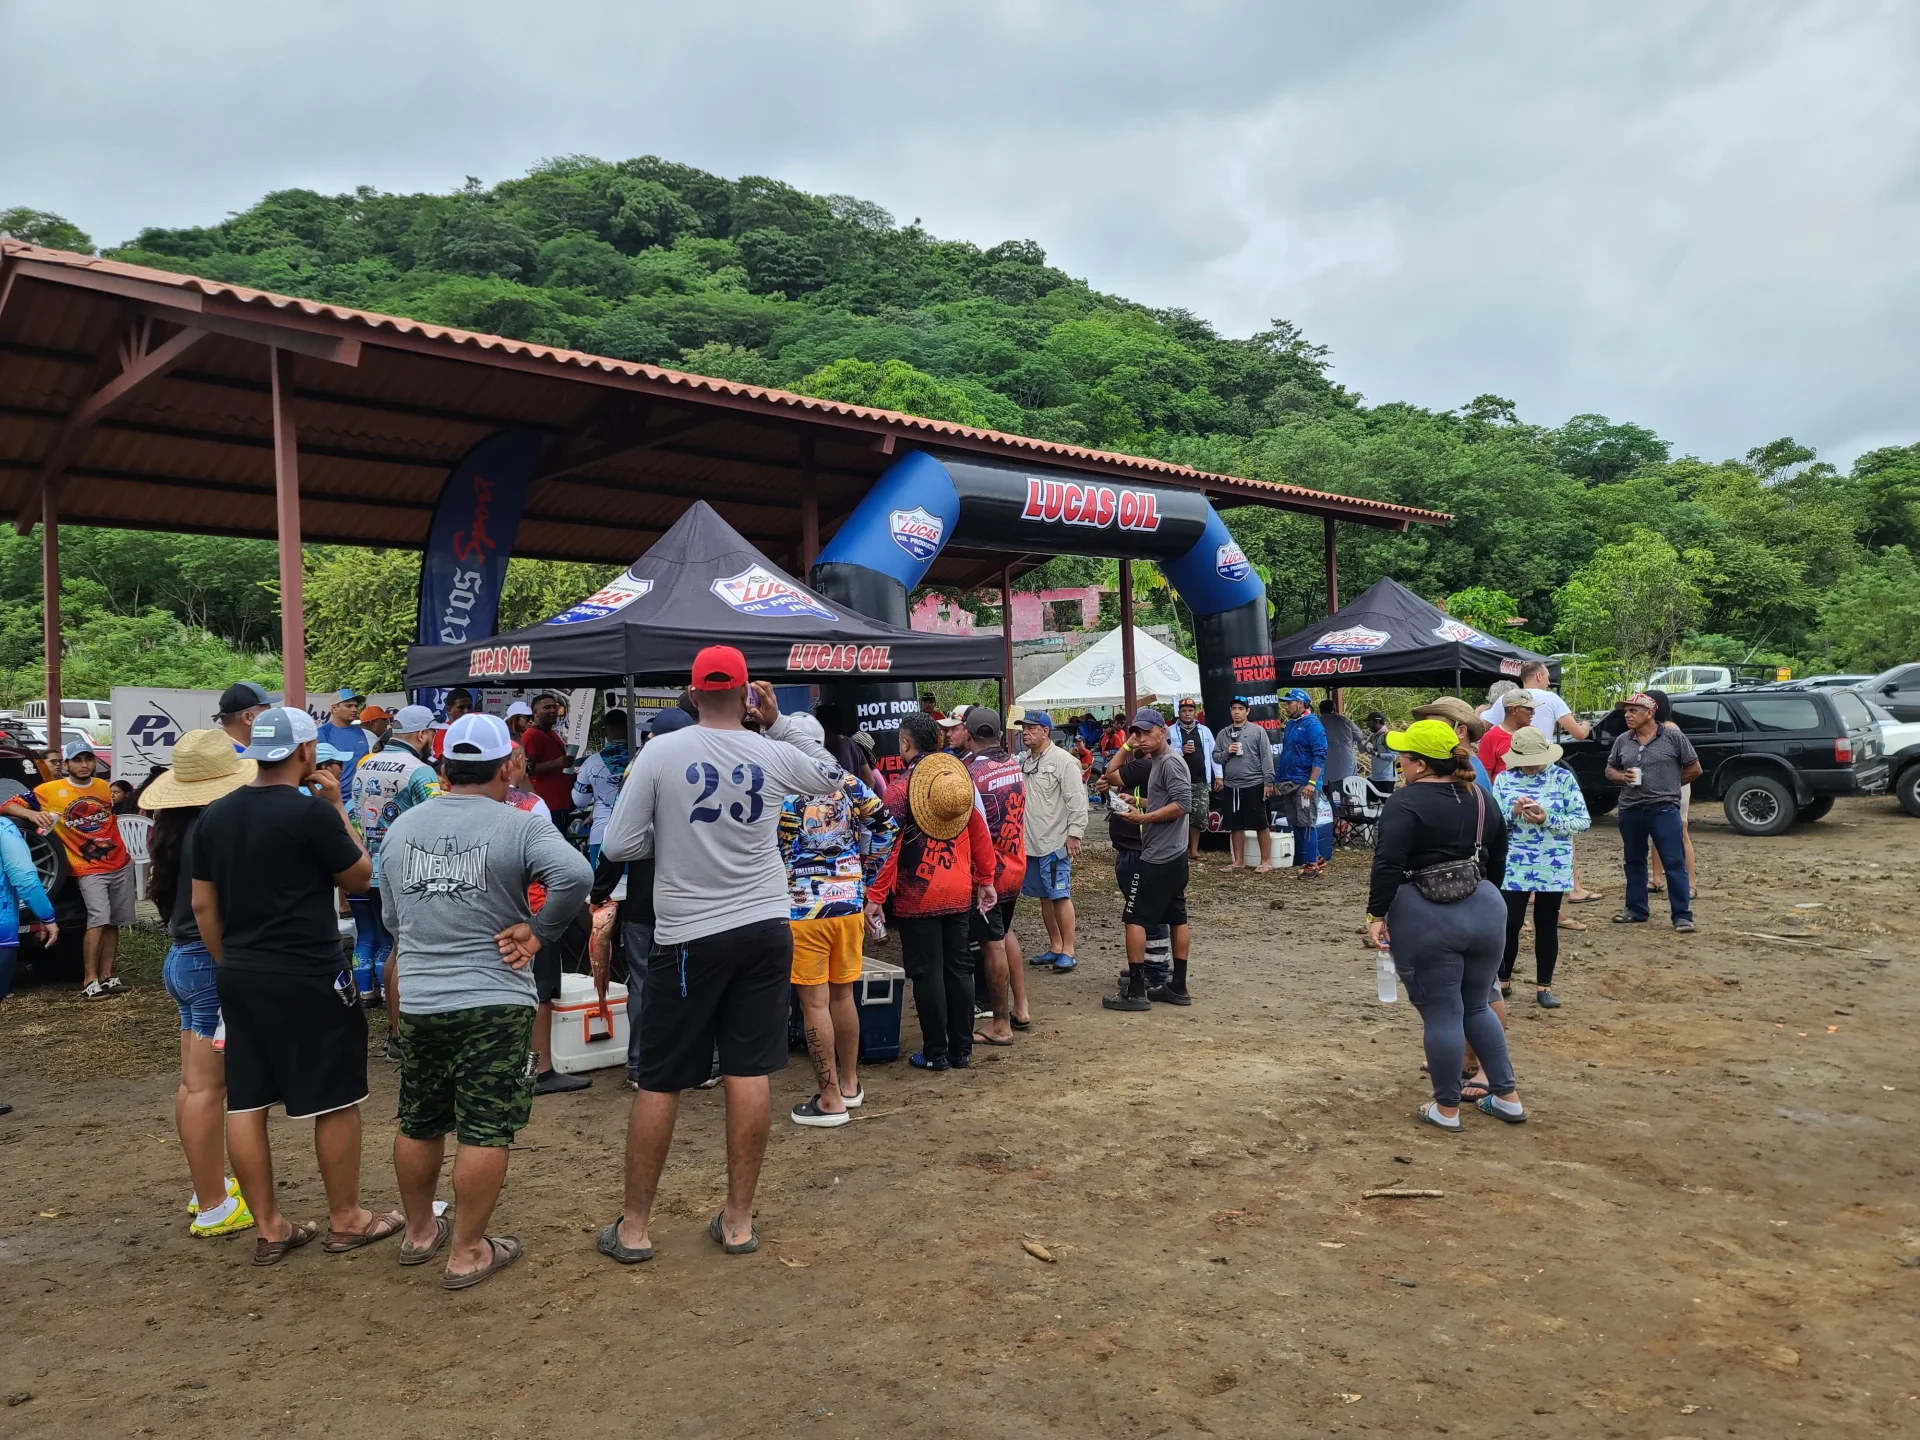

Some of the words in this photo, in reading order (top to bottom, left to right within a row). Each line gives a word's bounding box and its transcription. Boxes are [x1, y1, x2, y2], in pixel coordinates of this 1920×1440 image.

[1020, 478, 1116, 529] LUCAS
[1118, 489, 1162, 532] OIL
[900, 522, 939, 540] LUCAS
[743, 603, 769, 612] OIL
[469, 646, 508, 676] LUCAS
[509, 645, 532, 674] OIL
[786, 644, 858, 672] LUCAS
[858, 645, 893, 673] OIL
[1232, 656, 1269, 669] HEAVY
[1292, 658, 1337, 676] LUCAS
[1338, 656, 1362, 673] OIL
[639, 698, 660, 708] CHAME
[857, 701, 887, 717] HOT
[890, 700, 919, 714] RODS
[361, 759, 407, 773] MENDOZA
[685, 761, 765, 824] 23
[402, 842, 488, 893] LINEMAN
[427, 883, 460, 892] 507
[1126, 873, 1140, 913] FRANCO
